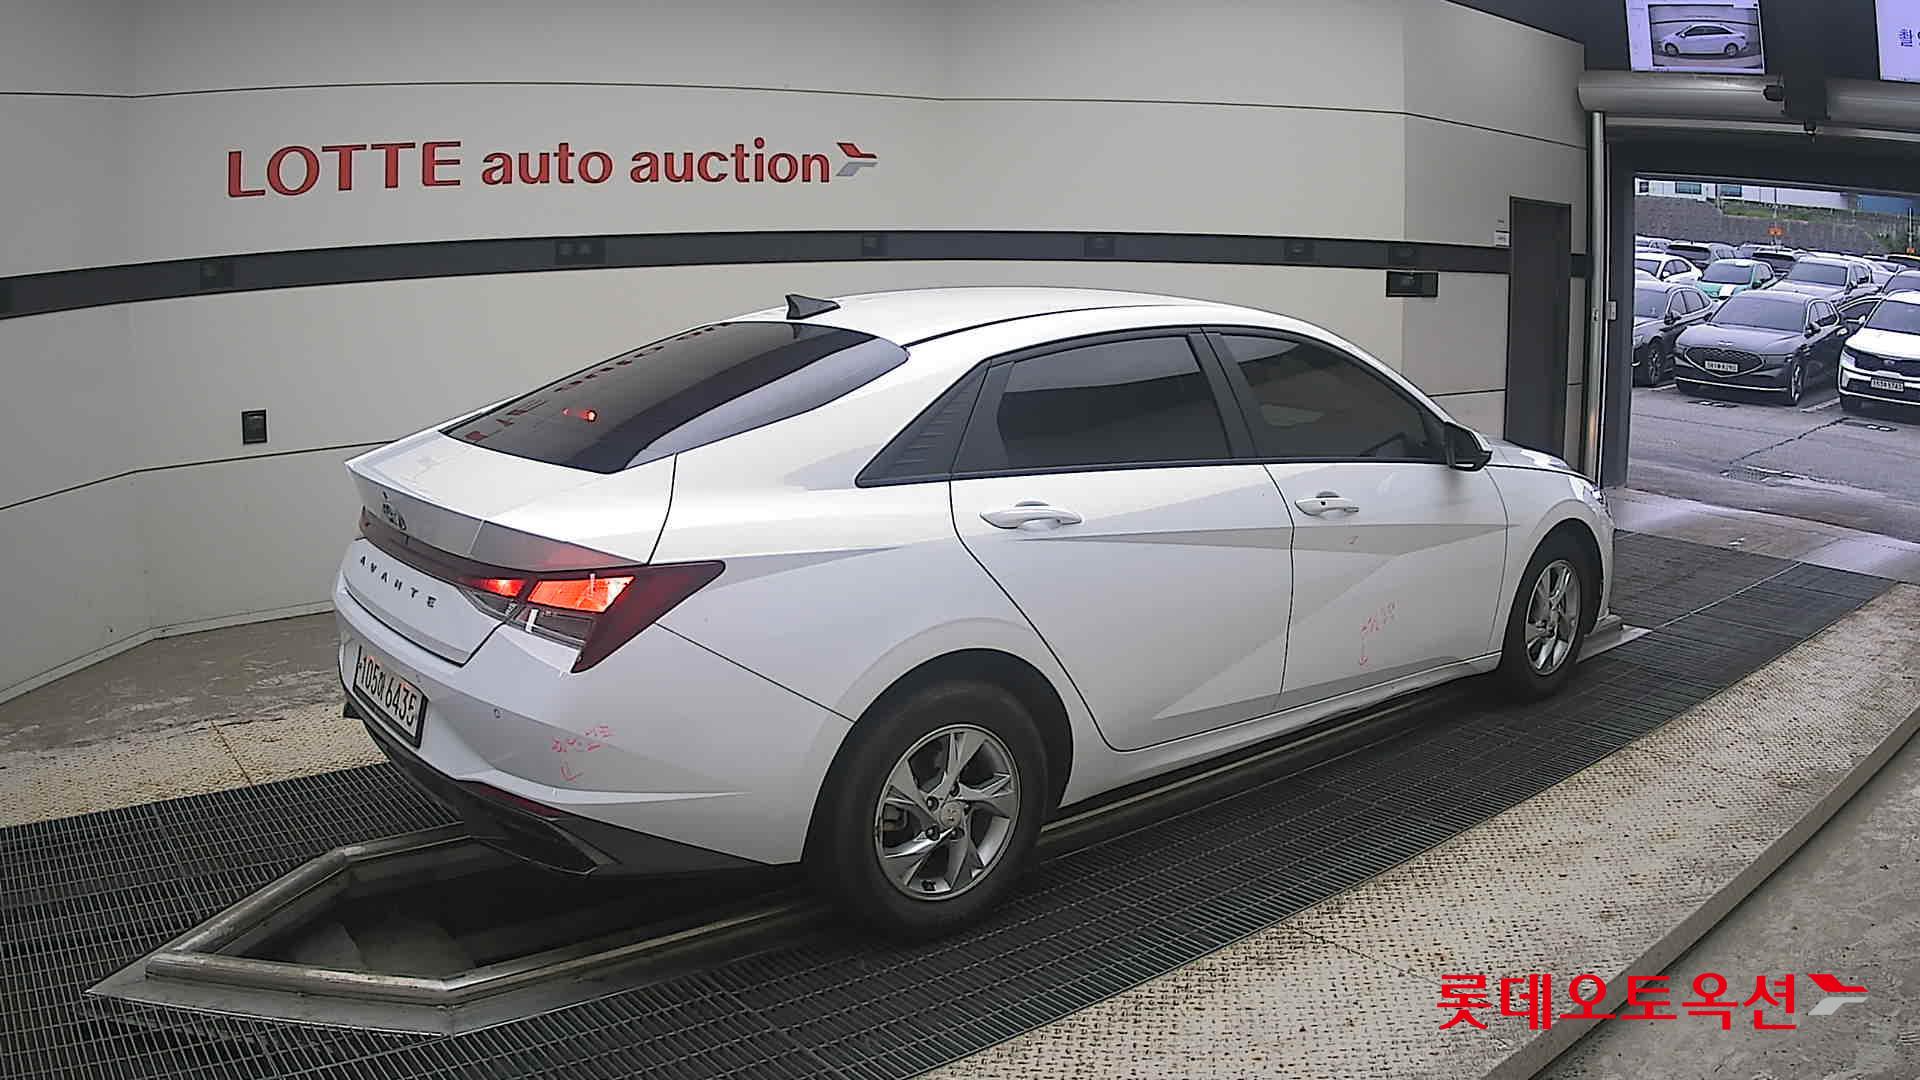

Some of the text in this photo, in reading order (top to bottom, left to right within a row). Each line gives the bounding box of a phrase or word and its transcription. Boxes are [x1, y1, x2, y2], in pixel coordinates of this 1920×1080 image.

[226, 137, 830, 198] LOTTE auto auction
[359, 555, 437, 608] AVANTE
[385, 676, 418, 727] 6435
